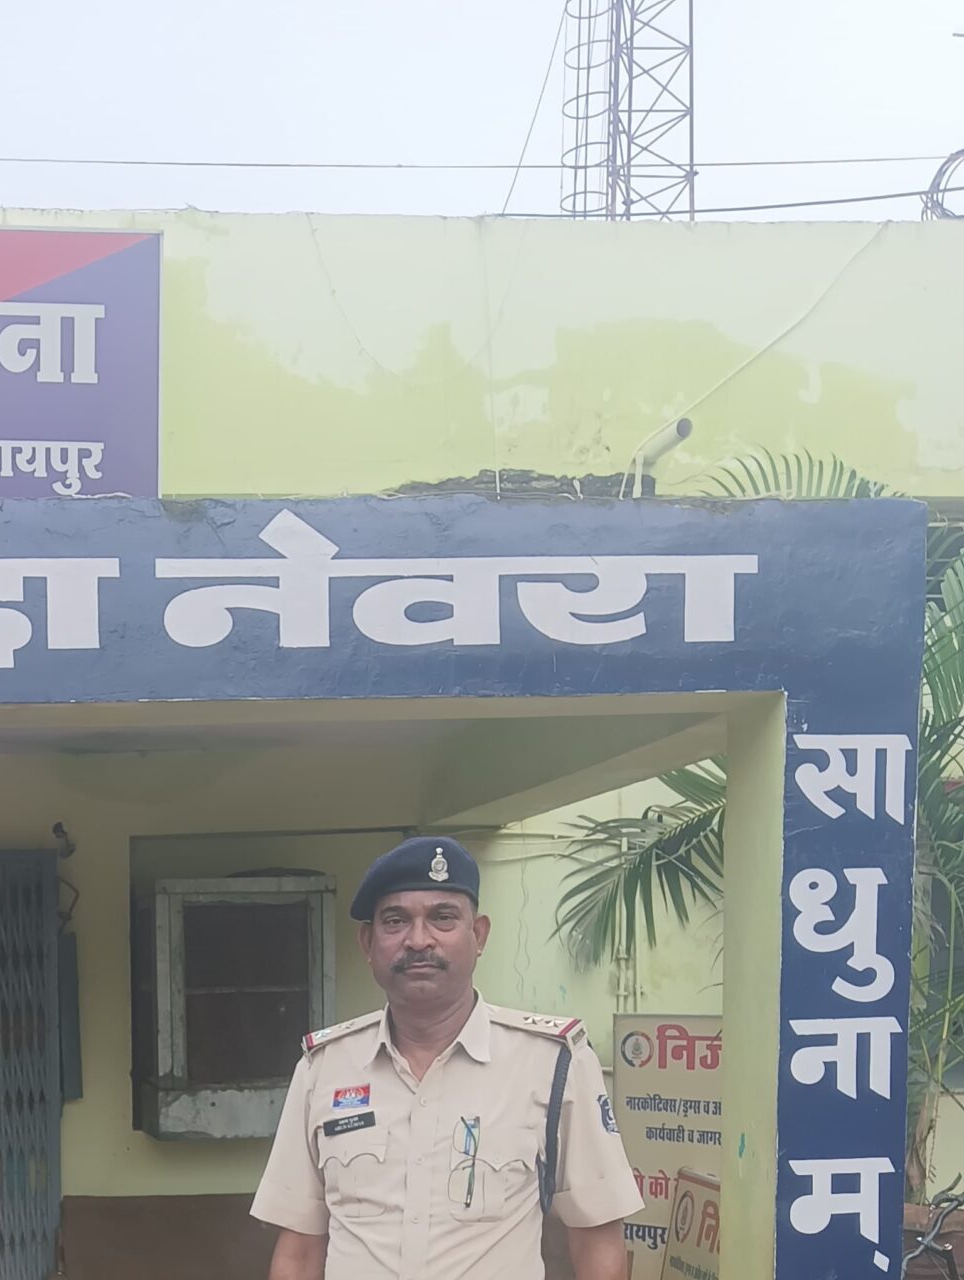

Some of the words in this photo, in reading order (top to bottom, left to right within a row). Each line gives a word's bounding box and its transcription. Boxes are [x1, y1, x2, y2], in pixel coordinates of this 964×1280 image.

[155, 507, 759, 649] नेवरा
[656, 1024, 723, 1071] निज
[696, 1128, 722, 1146] जागर
